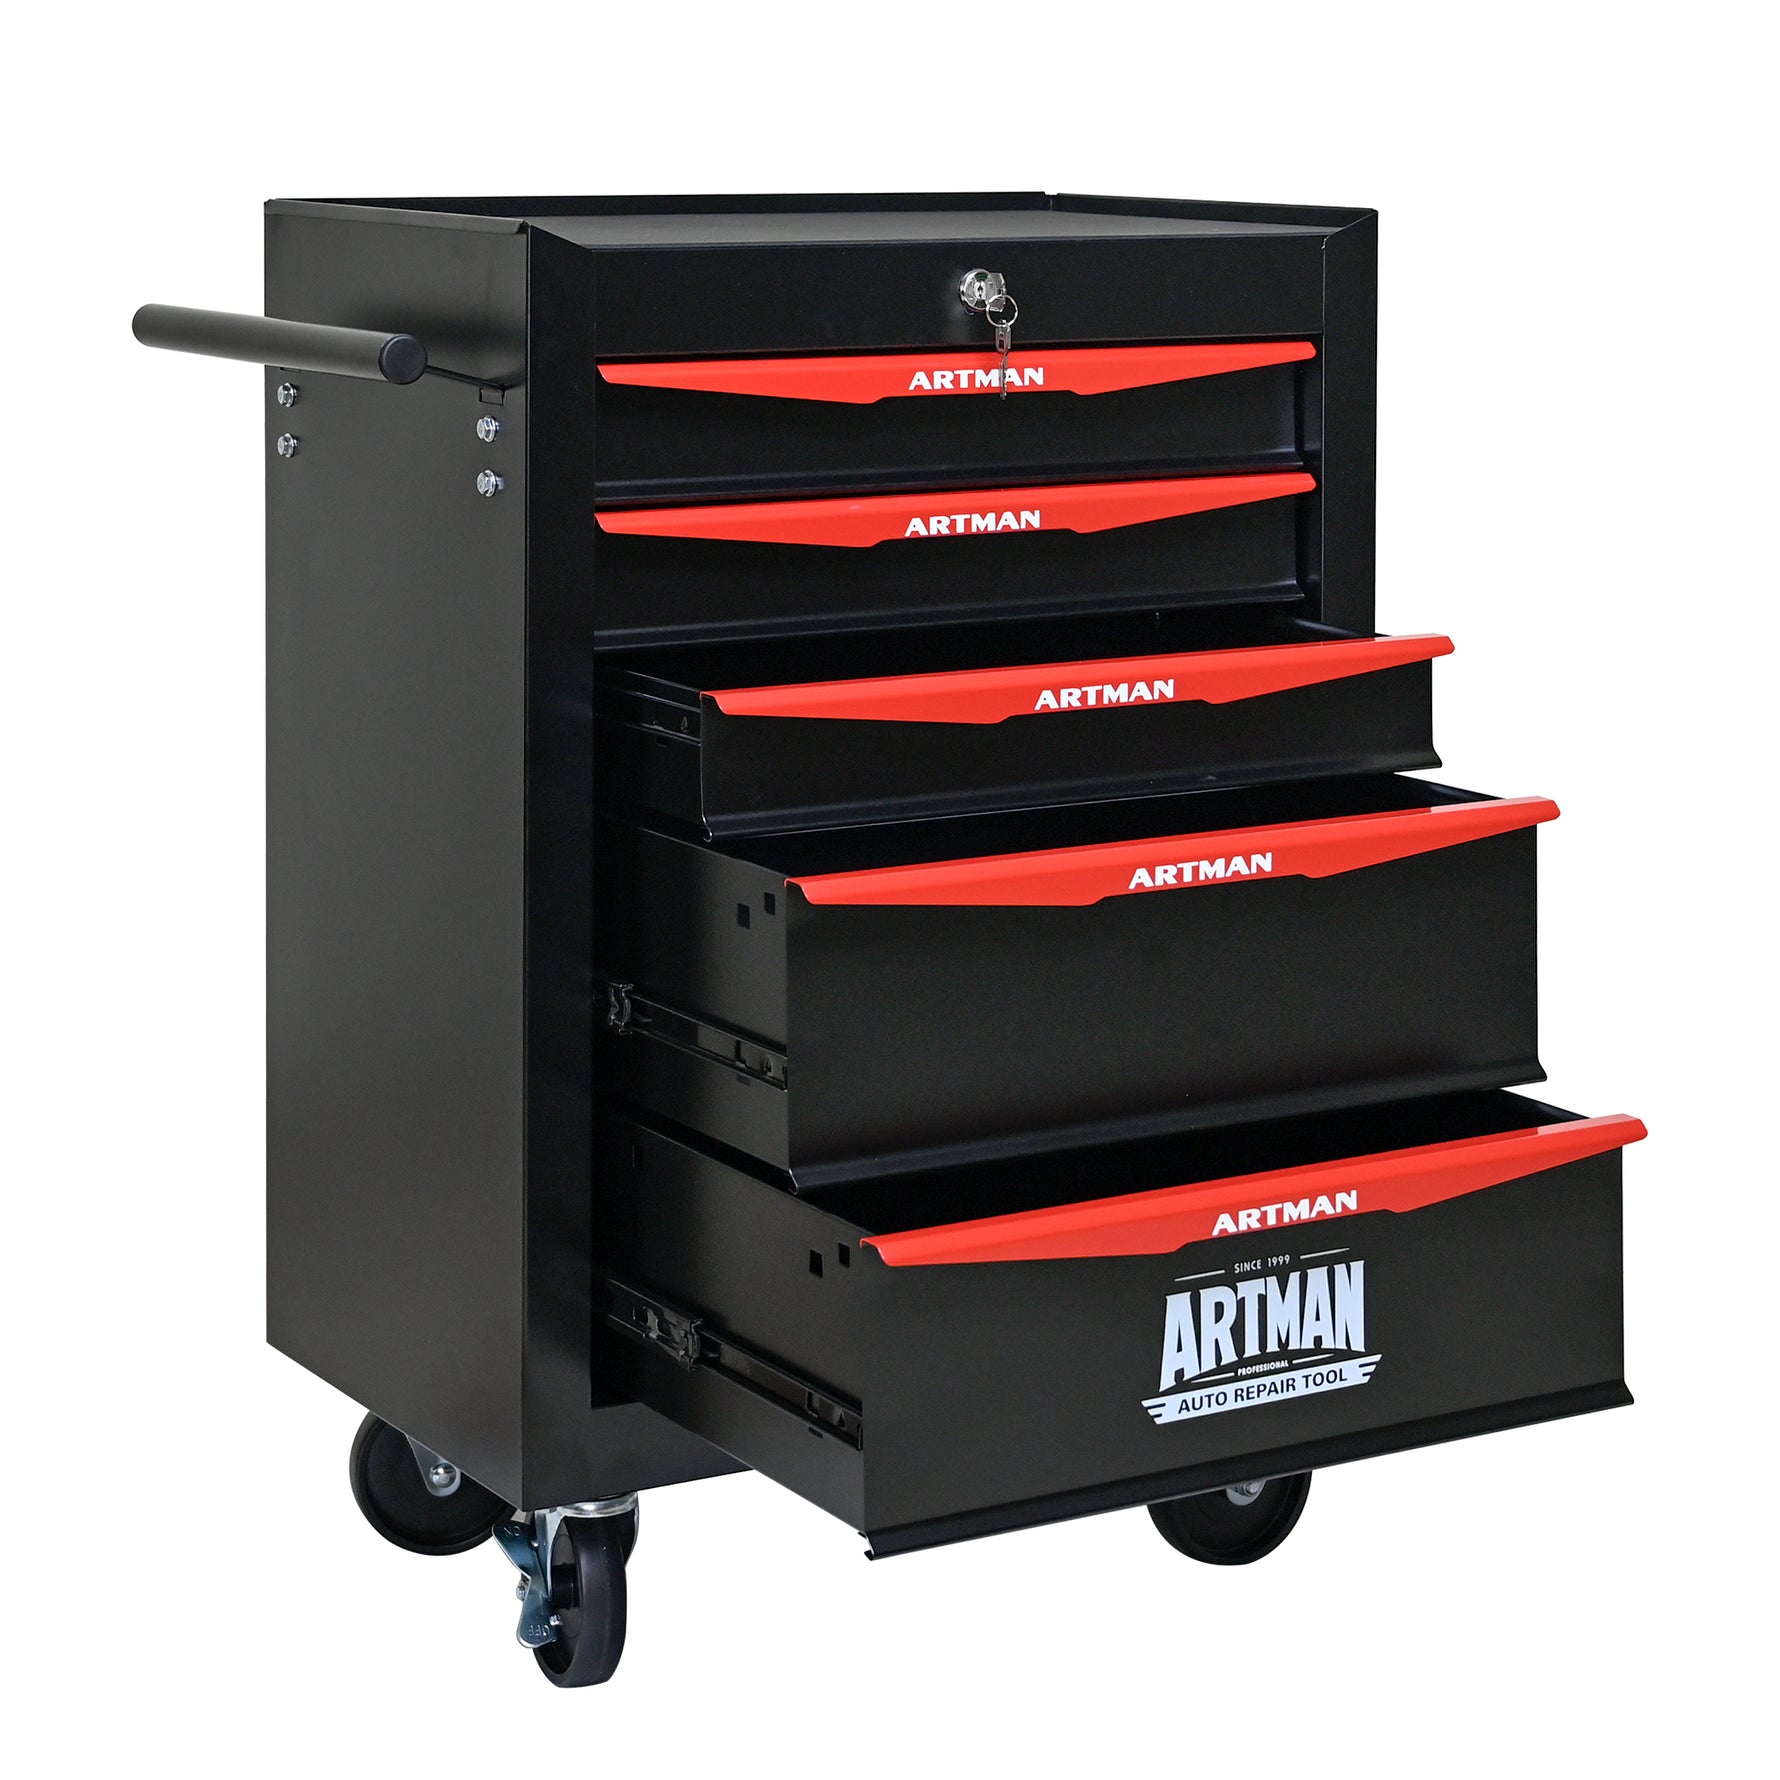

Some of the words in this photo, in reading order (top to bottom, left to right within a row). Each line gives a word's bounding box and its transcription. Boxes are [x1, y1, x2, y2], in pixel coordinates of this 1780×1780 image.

[908, 367, 1044, 391] ARTMAN
[904, 509, 1041, 537] ARTMAN
[1034, 678, 1175, 711] ARTMAN
[1128, 851, 1274, 891] ARTMAN
[1211, 1189, 1359, 1237] ARTMAN
[1234, 1259, 1262, 1274] SINCE
[1267, 1254, 1290, 1268] 1999
[1158, 1259, 1366, 1393] ARTMAN
[1237, 1359, 1289, 1376] PROFESSIONAL
[1178, 1390, 1228, 1415] AUTO
[1234, 1377, 1296, 1403] REPAIR
[1301, 1367, 1348, 1389] TOOL
